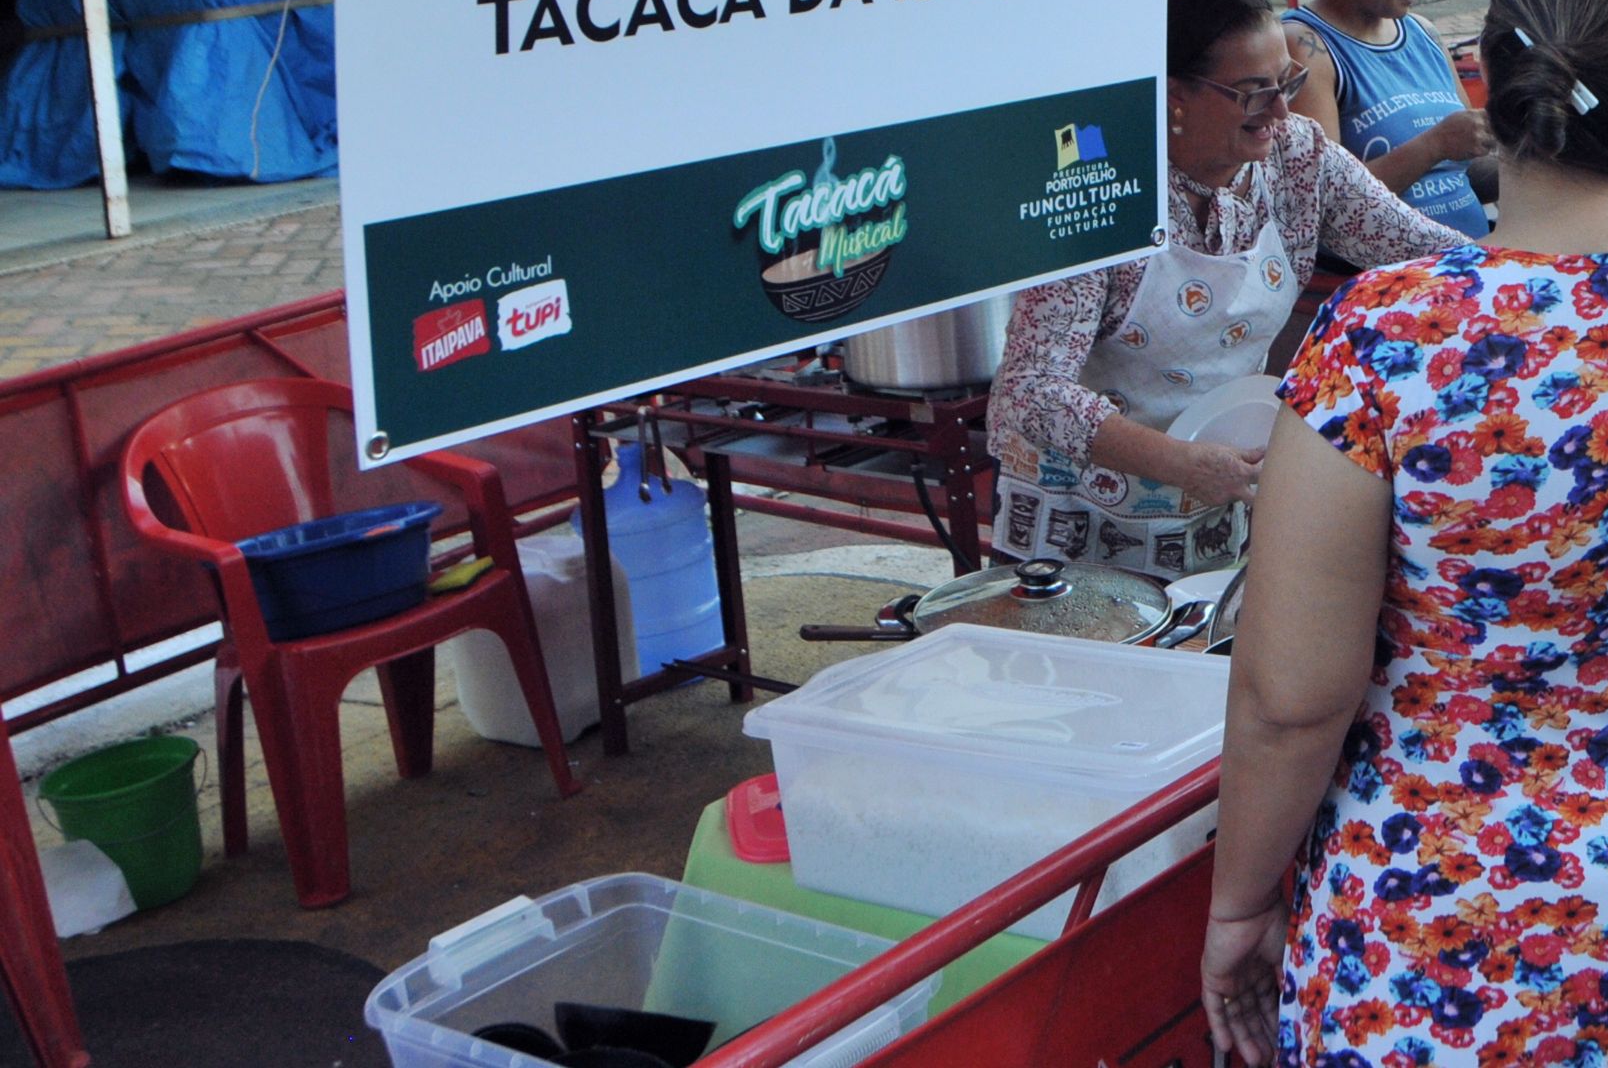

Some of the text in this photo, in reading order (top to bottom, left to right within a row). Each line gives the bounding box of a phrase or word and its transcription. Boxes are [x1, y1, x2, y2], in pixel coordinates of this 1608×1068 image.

[1351, 93, 1426, 134] ATHLETIC
[1045, 167, 1117, 194] PORTO VELHO
[1053, 160, 1110, 179] PREFEITURA
[734, 153, 905, 252] Tacacá
[1020, 178, 1142, 220] FUNCULTURAL
[1047, 202, 1117, 228] FUNDAÇÃO
[818, 202, 906, 276] Musical
[1049, 215, 1115, 240] CULTURAL
[429, 254, 553, 303] Apoio Cultural
[421, 315, 486, 371] ITAIPAVA
